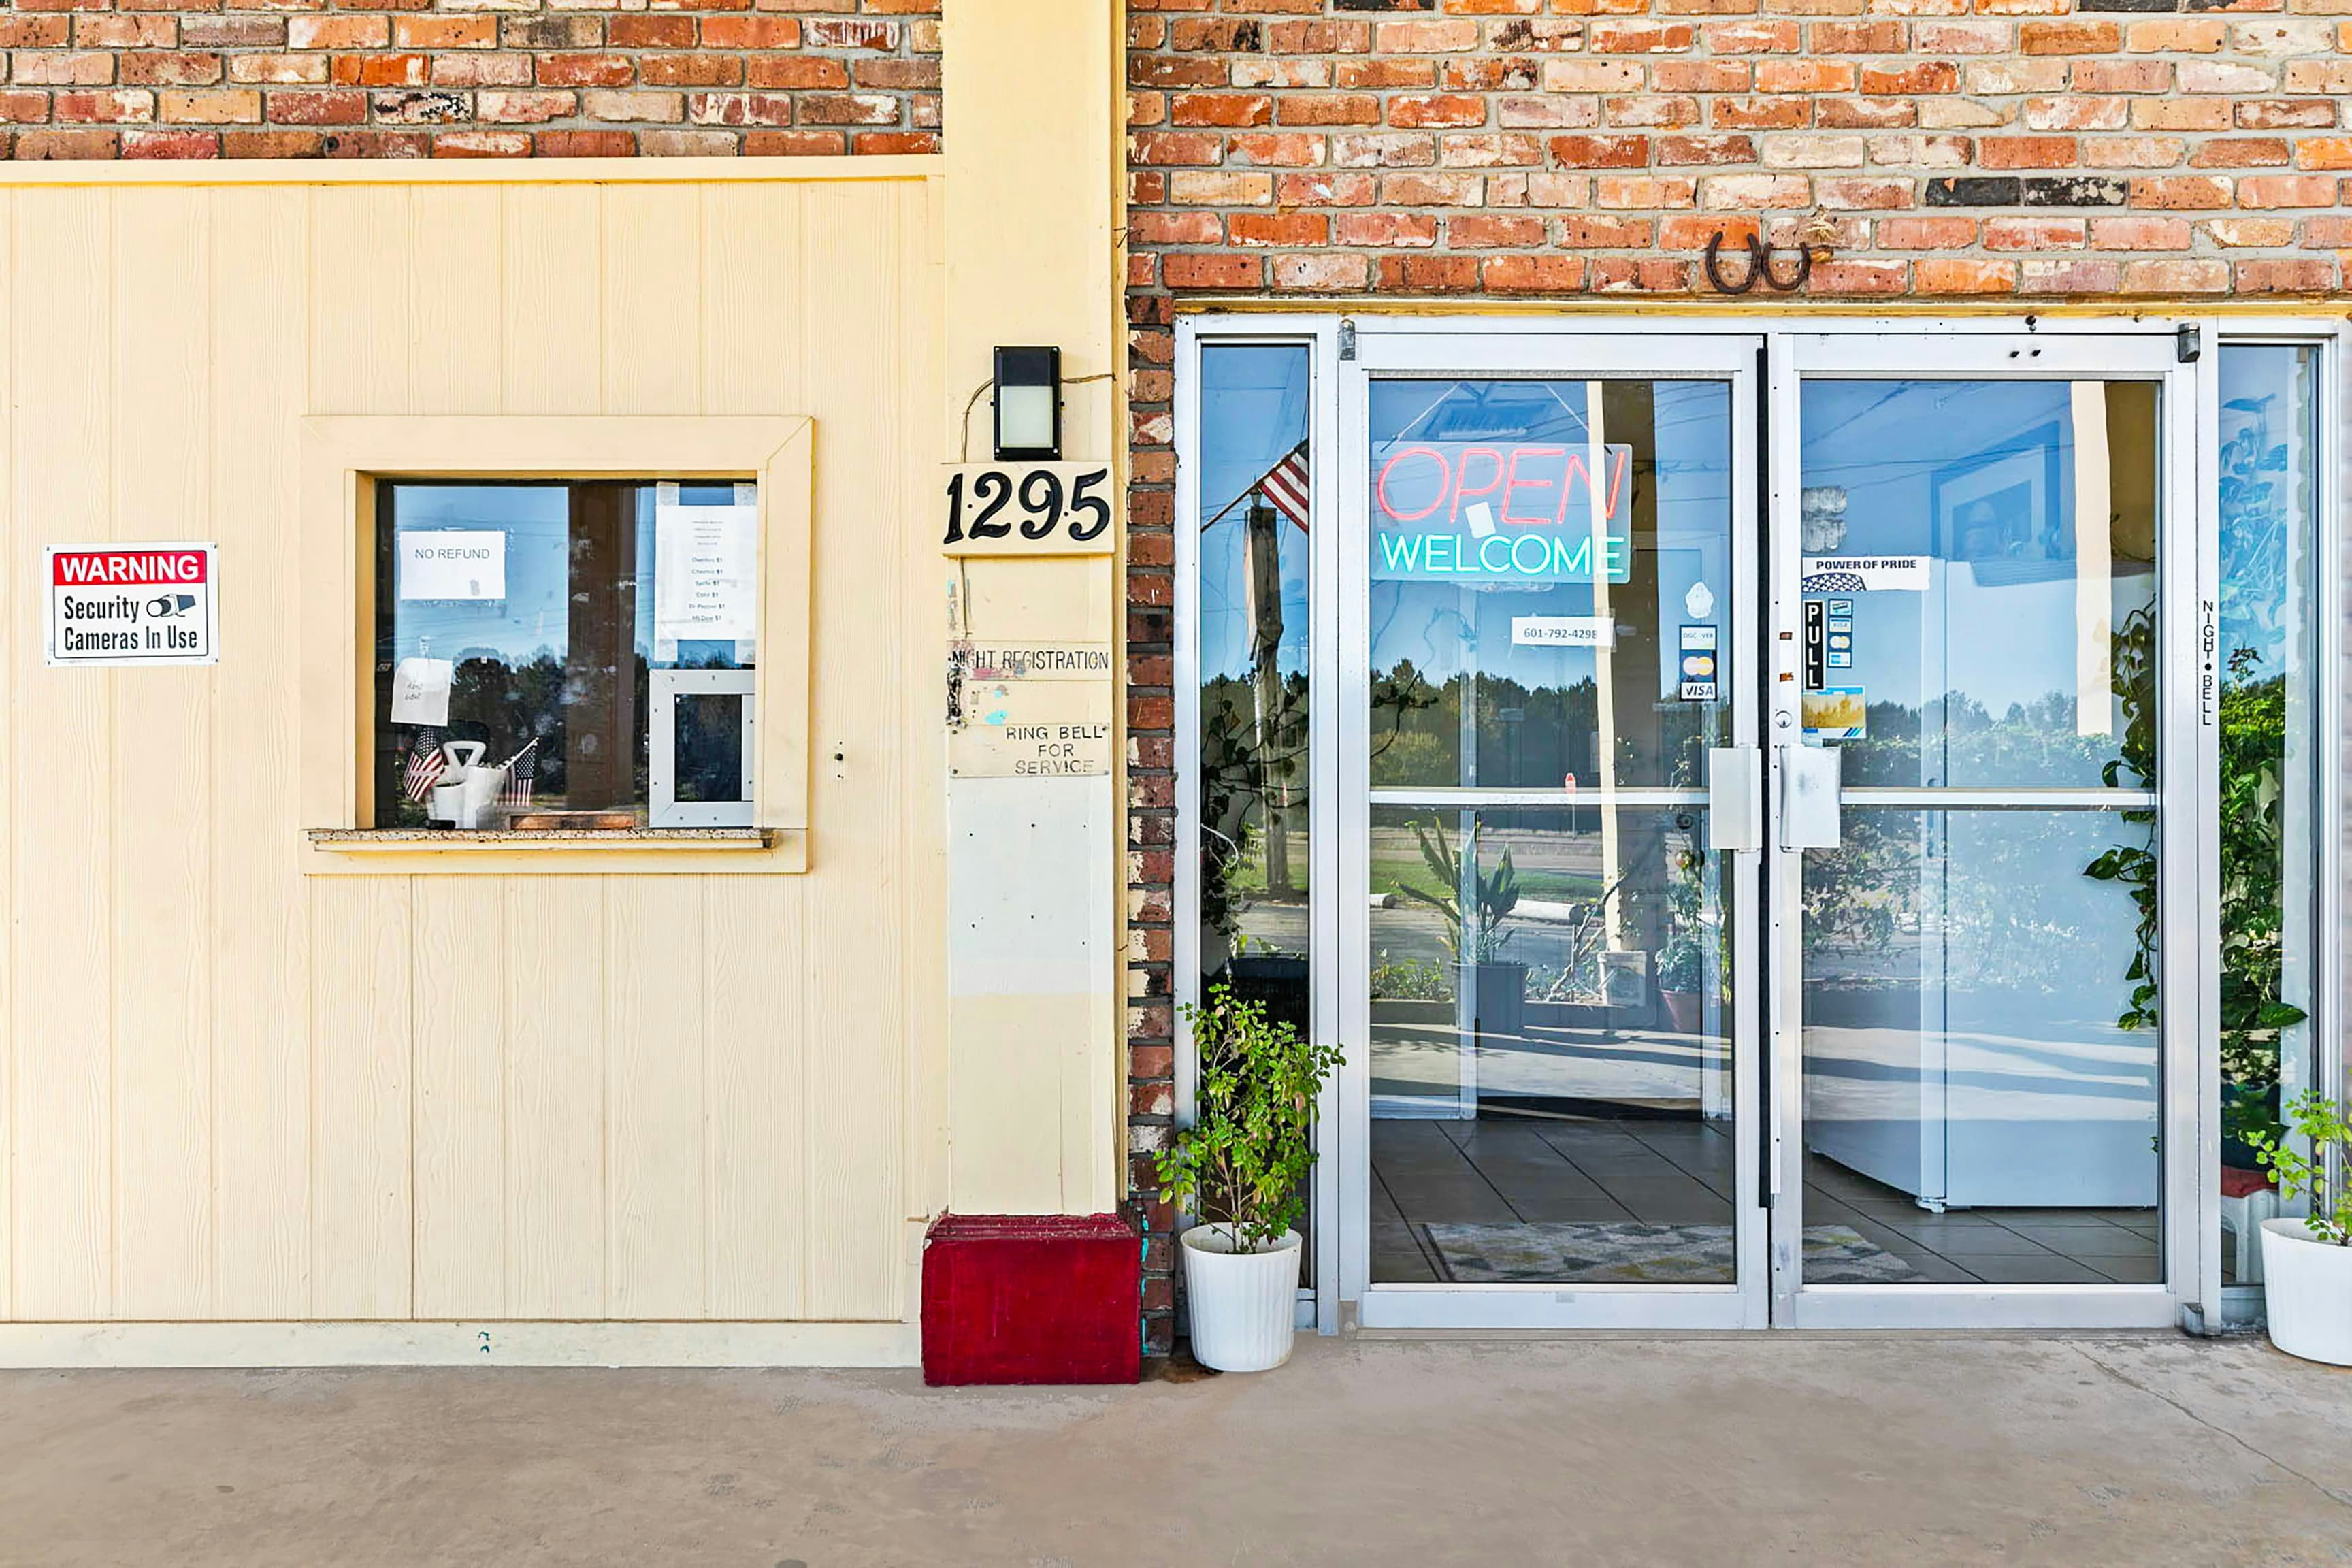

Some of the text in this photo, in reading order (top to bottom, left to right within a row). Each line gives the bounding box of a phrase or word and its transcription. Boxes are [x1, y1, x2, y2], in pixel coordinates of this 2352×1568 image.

[1377, 446, 1626, 524] OPEN
[943, 468, 1111, 544] 1295
[415, 549, 490, 559] NO REFUND
[1379, 532, 1625, 576] WELCOME
[1816, 559, 1917, 570] POWER OF PRIDE
[61, 555, 199, 582] WARNING
[65, 595, 139, 623] Security
[65, 625, 197, 651] Cameras In Use
[1524, 628, 1598, 640] 601-792-4298
[1808, 604, 1820, 687] PULL
[952, 651, 1109, 670] NIGHT REGISTRATION
[2203, 600, 2214, 725] NIGHT BELL
[1686, 685, 1714, 696] VISA
[1007, 725, 1103, 740] RING BELL
[1038, 744, 1074, 757] FOR
[1015, 760, 1094, 775] SERVICE
